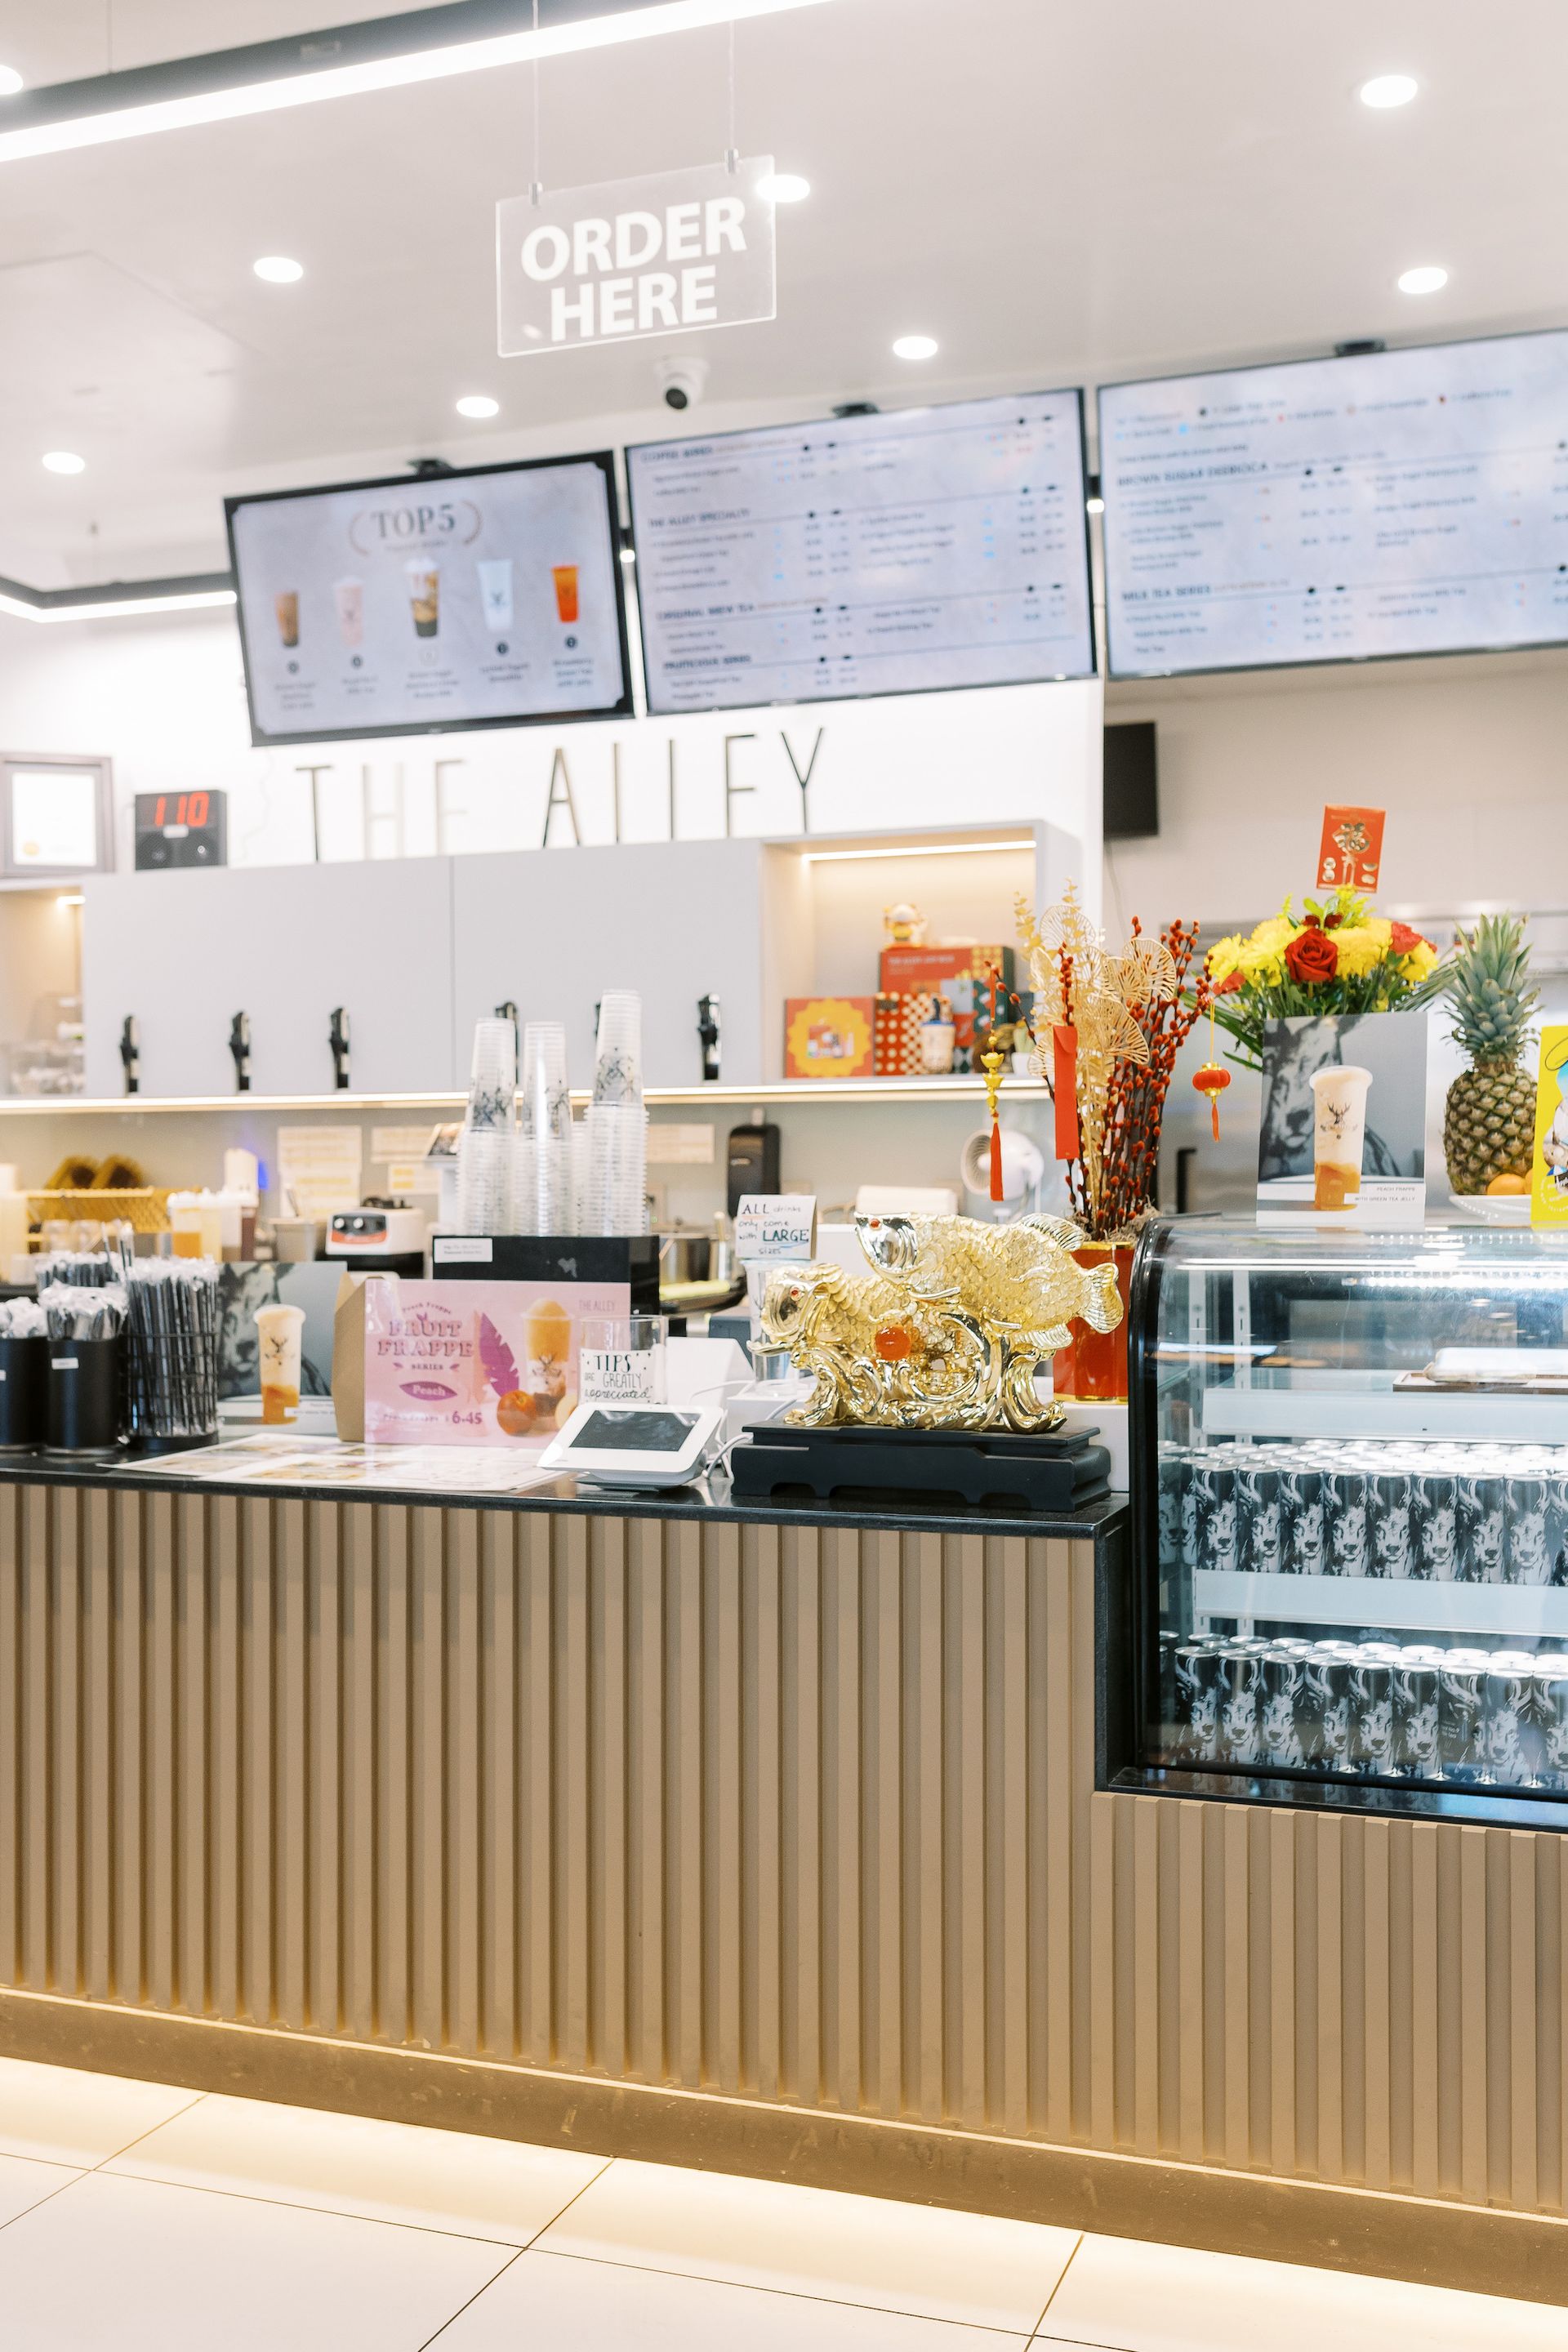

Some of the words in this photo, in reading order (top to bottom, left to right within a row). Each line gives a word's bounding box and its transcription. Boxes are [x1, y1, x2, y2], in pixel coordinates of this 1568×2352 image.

[521, 197, 747, 281] ORDER
[551, 265, 717, 342] HERE
[742, 1203, 769, 1214] ALL
[738, 1220, 758, 1232] only
[739, 1232, 757, 1241] with
[763, 1228, 809, 1242] LARGE
[579, 1299, 591, 1311] THE
[595, 1299, 615, 1311] ALLEY
[389, 1319, 463, 1337] FRUIT
[377, 1339, 474, 1357] FRAPPE
[595, 1354, 631, 1374] TIPS
[603, 1372, 641, 1388] GREATLY
[412, 1384, 446, 1396] Peach
